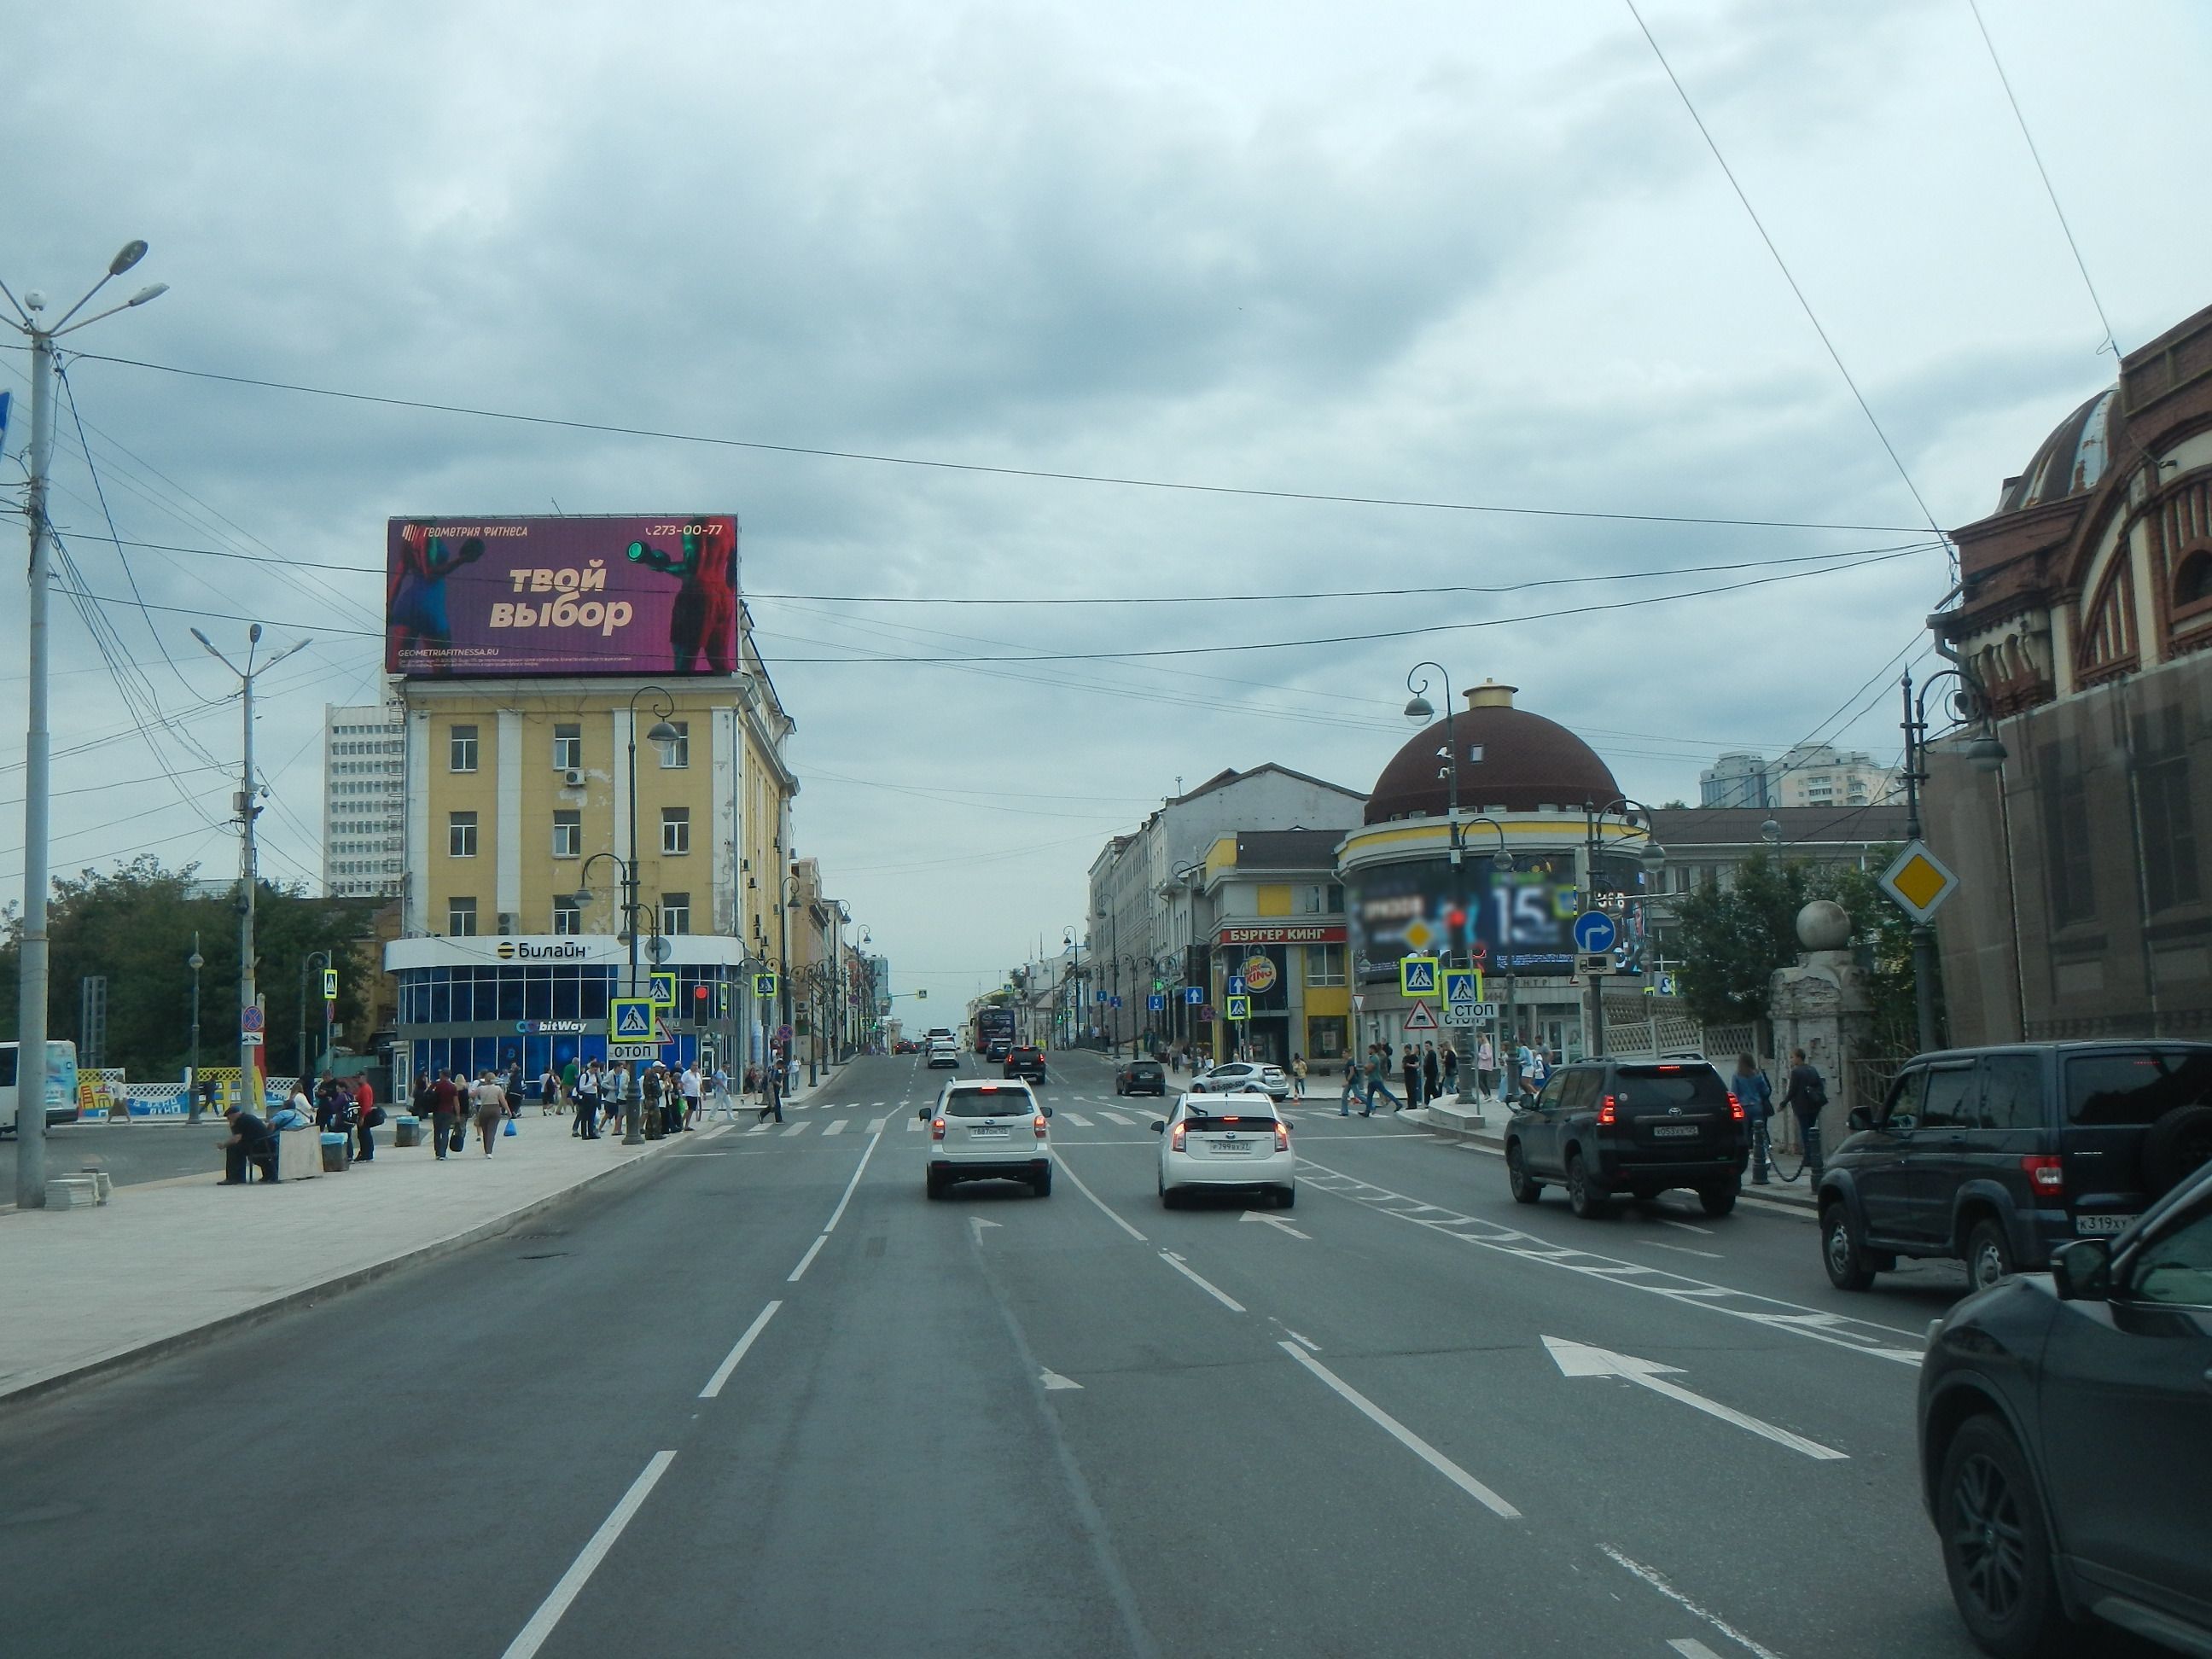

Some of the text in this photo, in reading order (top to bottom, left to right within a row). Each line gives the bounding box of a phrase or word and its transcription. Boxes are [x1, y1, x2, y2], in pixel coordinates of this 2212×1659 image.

[653, 524, 723, 536] 273-00-77
[398, 649, 499, 657] GEOMETRIAFITNESSA.RU
[1230, 929, 1284, 941] БУРГЕР
[1287, 928, 1324, 940] КИНГ
[519, 941, 585, 958] Билайн
[1454, 1004, 1494, 1016] СТОП
[539, 1021, 587, 1033] bitWay
[614, 1046, 650, 1057] СТОП
